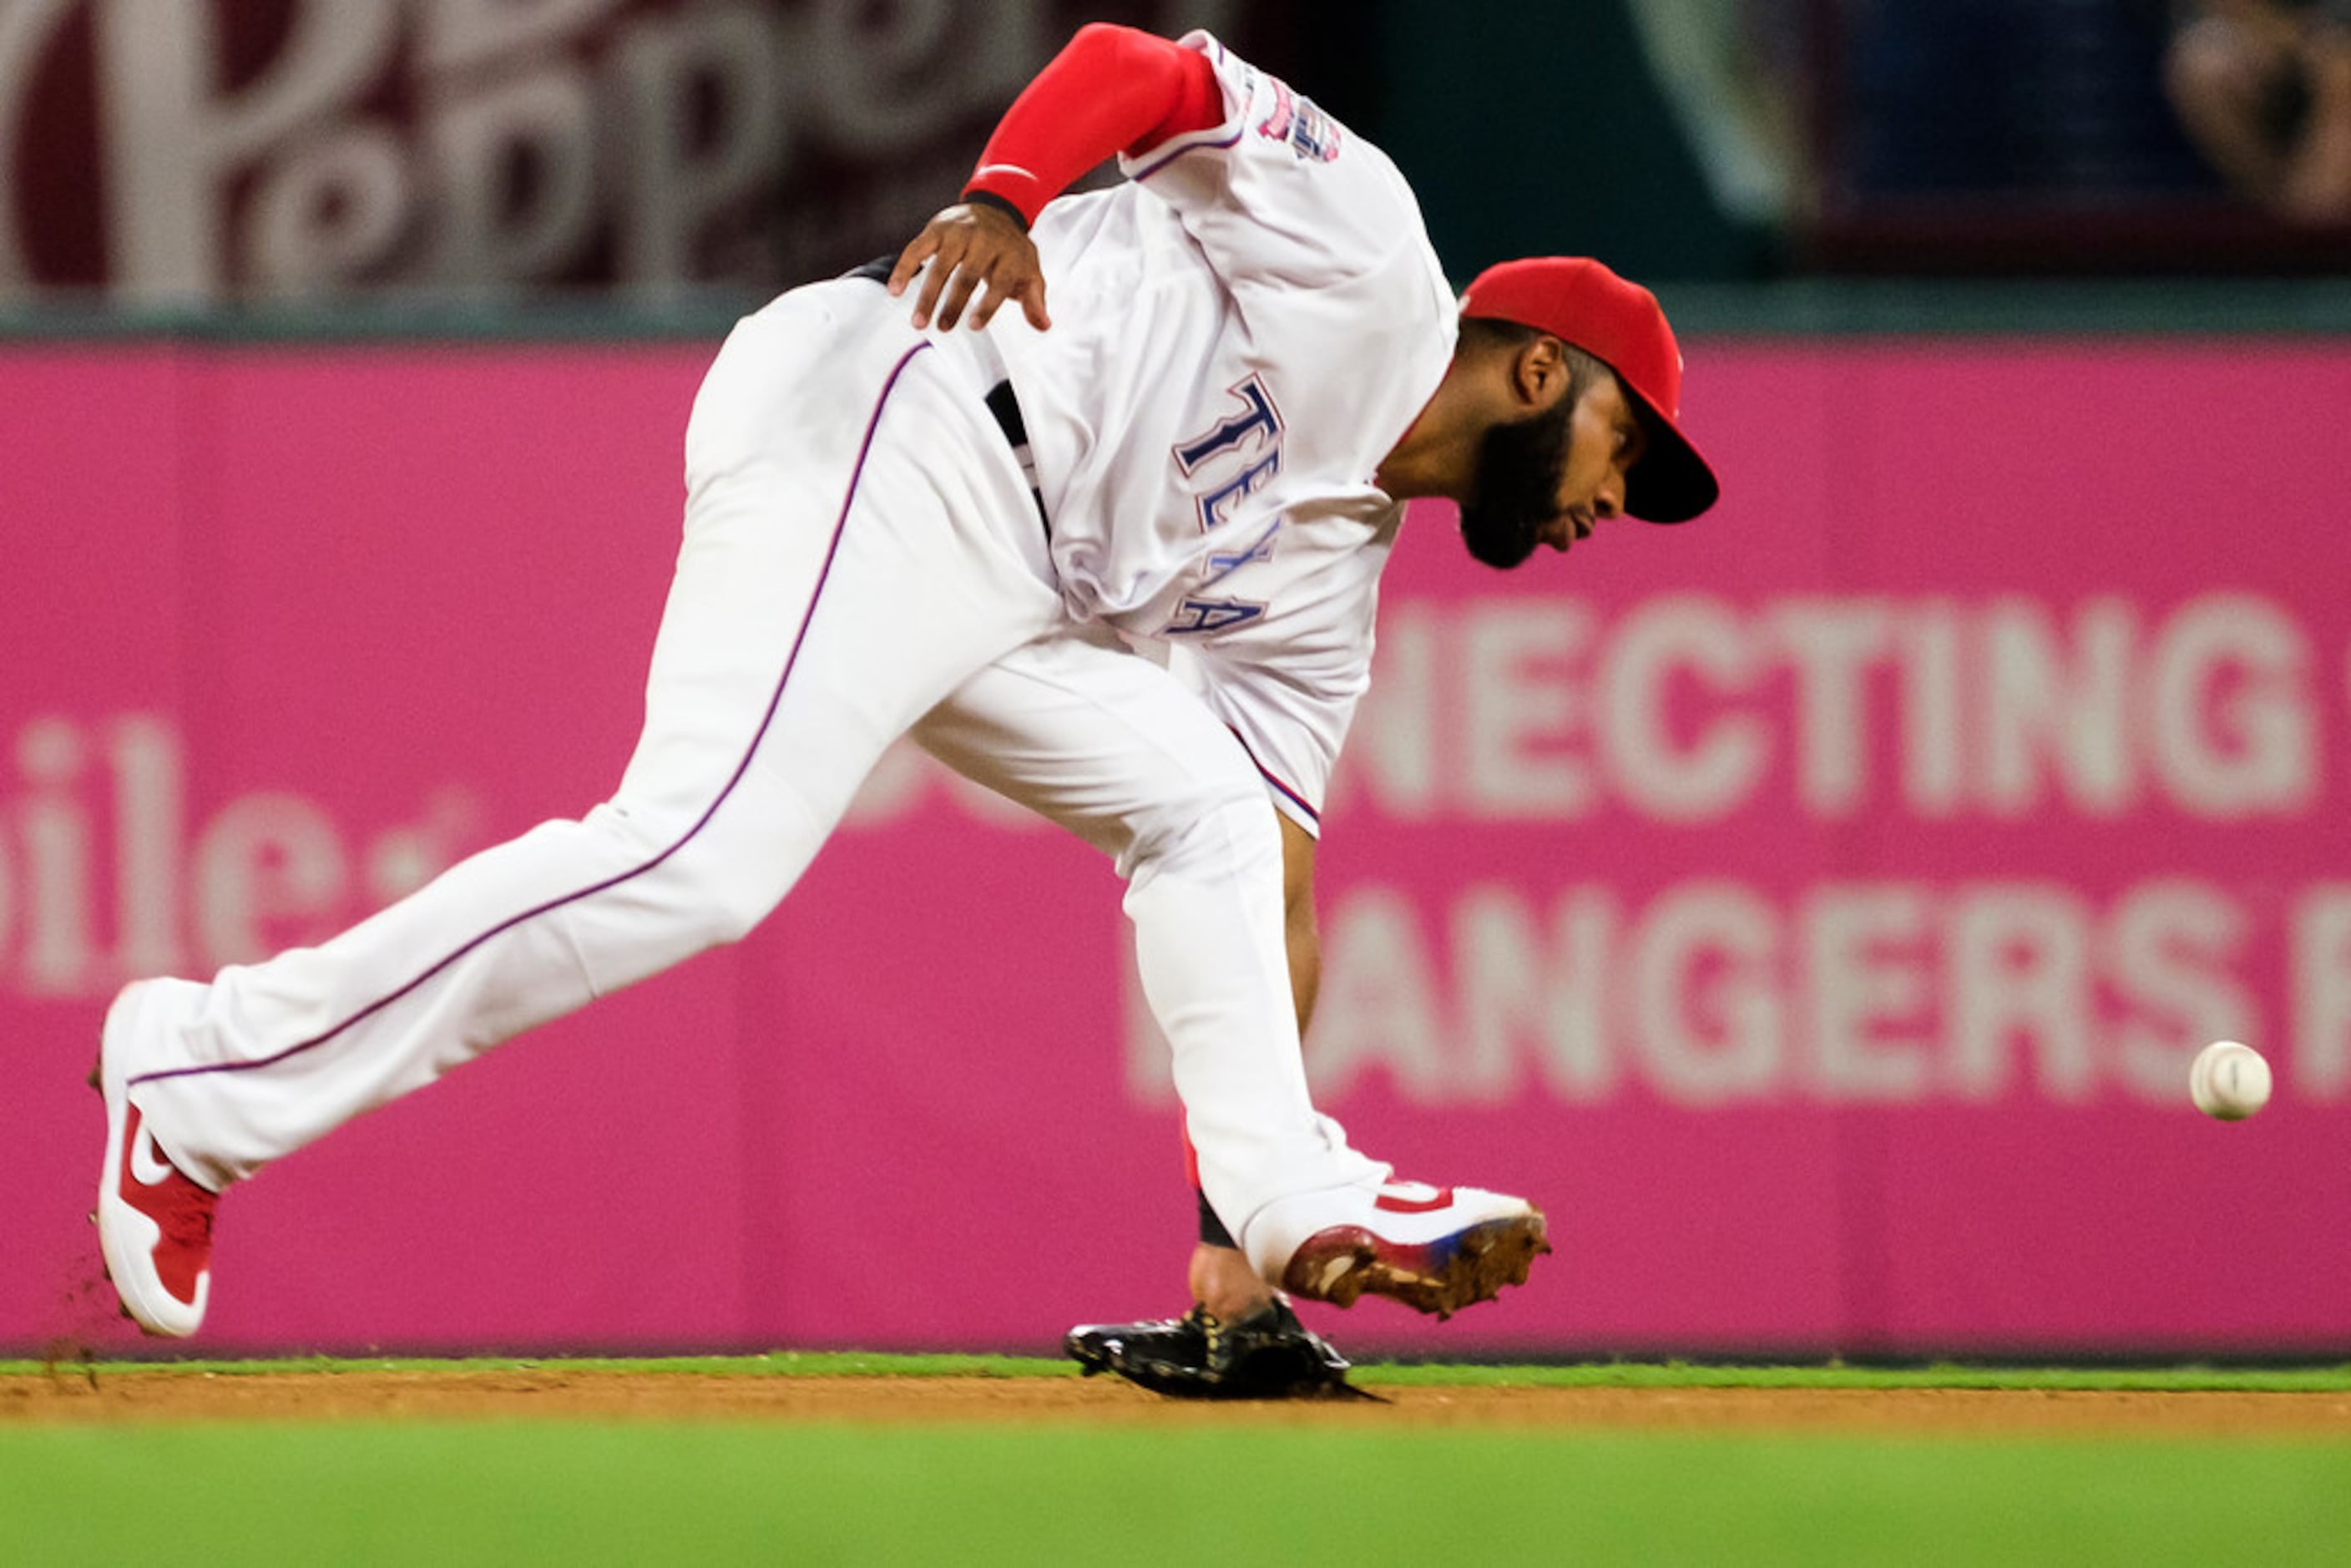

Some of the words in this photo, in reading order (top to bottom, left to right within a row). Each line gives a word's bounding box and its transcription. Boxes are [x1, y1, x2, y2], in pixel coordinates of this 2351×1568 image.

[79, 0, 1059, 288] Peppe
[1151, 372, 1286, 648] TEXA
[840, 591, 2326, 822] NECTING
[0, 714, 344, 997] ile
[1122, 878, 2259, 1107] ANGERS
